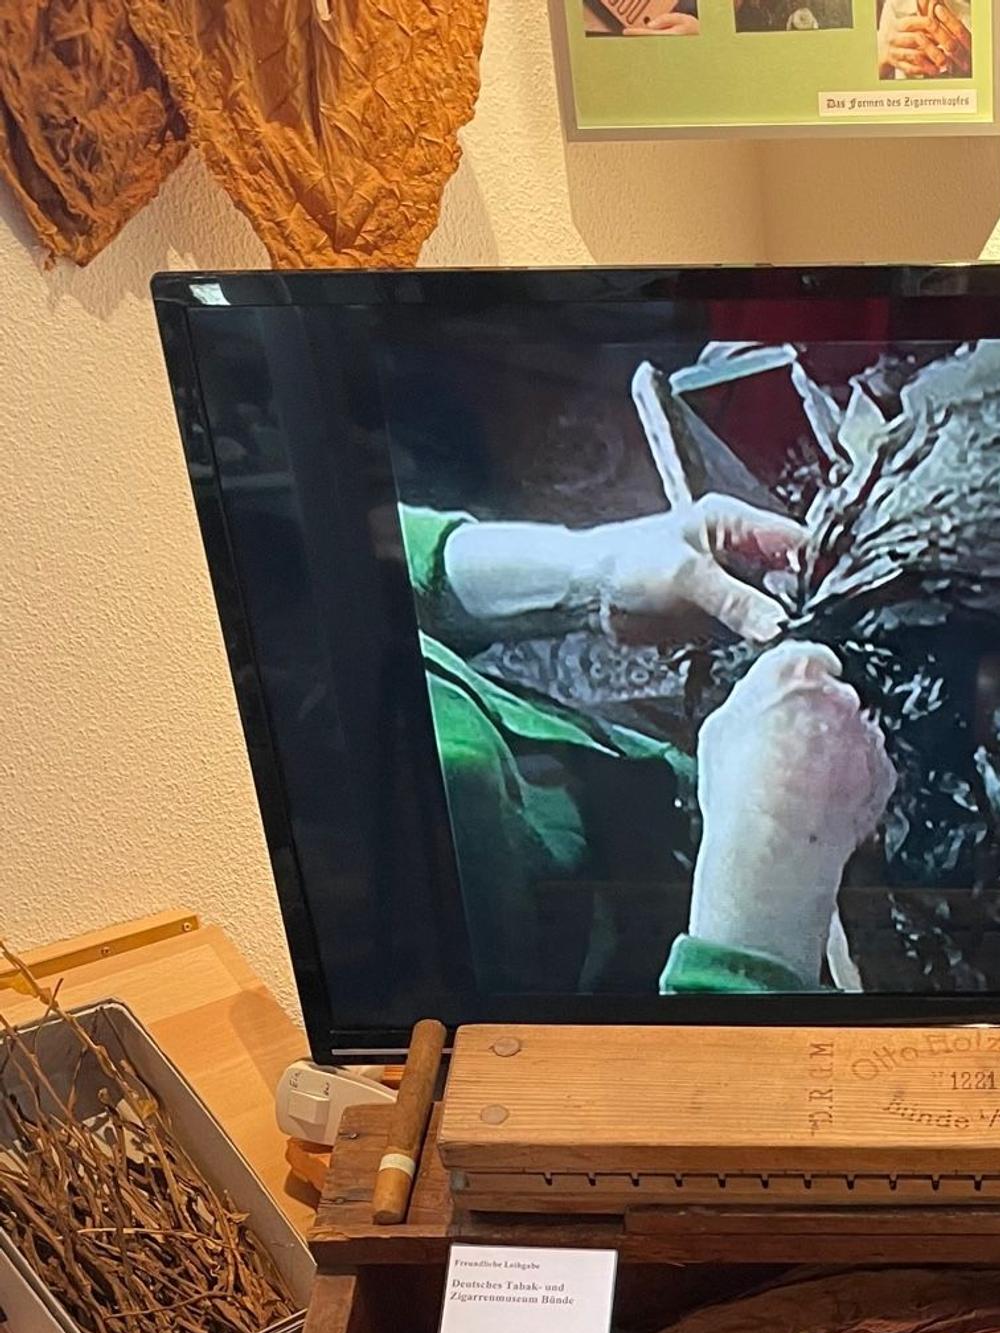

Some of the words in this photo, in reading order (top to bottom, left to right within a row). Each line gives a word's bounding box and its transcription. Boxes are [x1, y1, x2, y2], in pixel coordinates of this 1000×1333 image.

[826, 98, 845, 108] Das
[848, 97, 884, 110] Formen
[887, 97, 901, 107] des
[904, 96, 970, 109] Zigarrenkopfes
[851, 1045, 919, 1081] Otto
[451, 1278, 503, 1289] Deutsches
[505, 1281, 543, 1291] Tabak-
[544, 1282, 565, 1292] und
[449, 1291, 538, 1304] Zigarrenmuseum
[540, 1295, 575, 1305] Bünde
